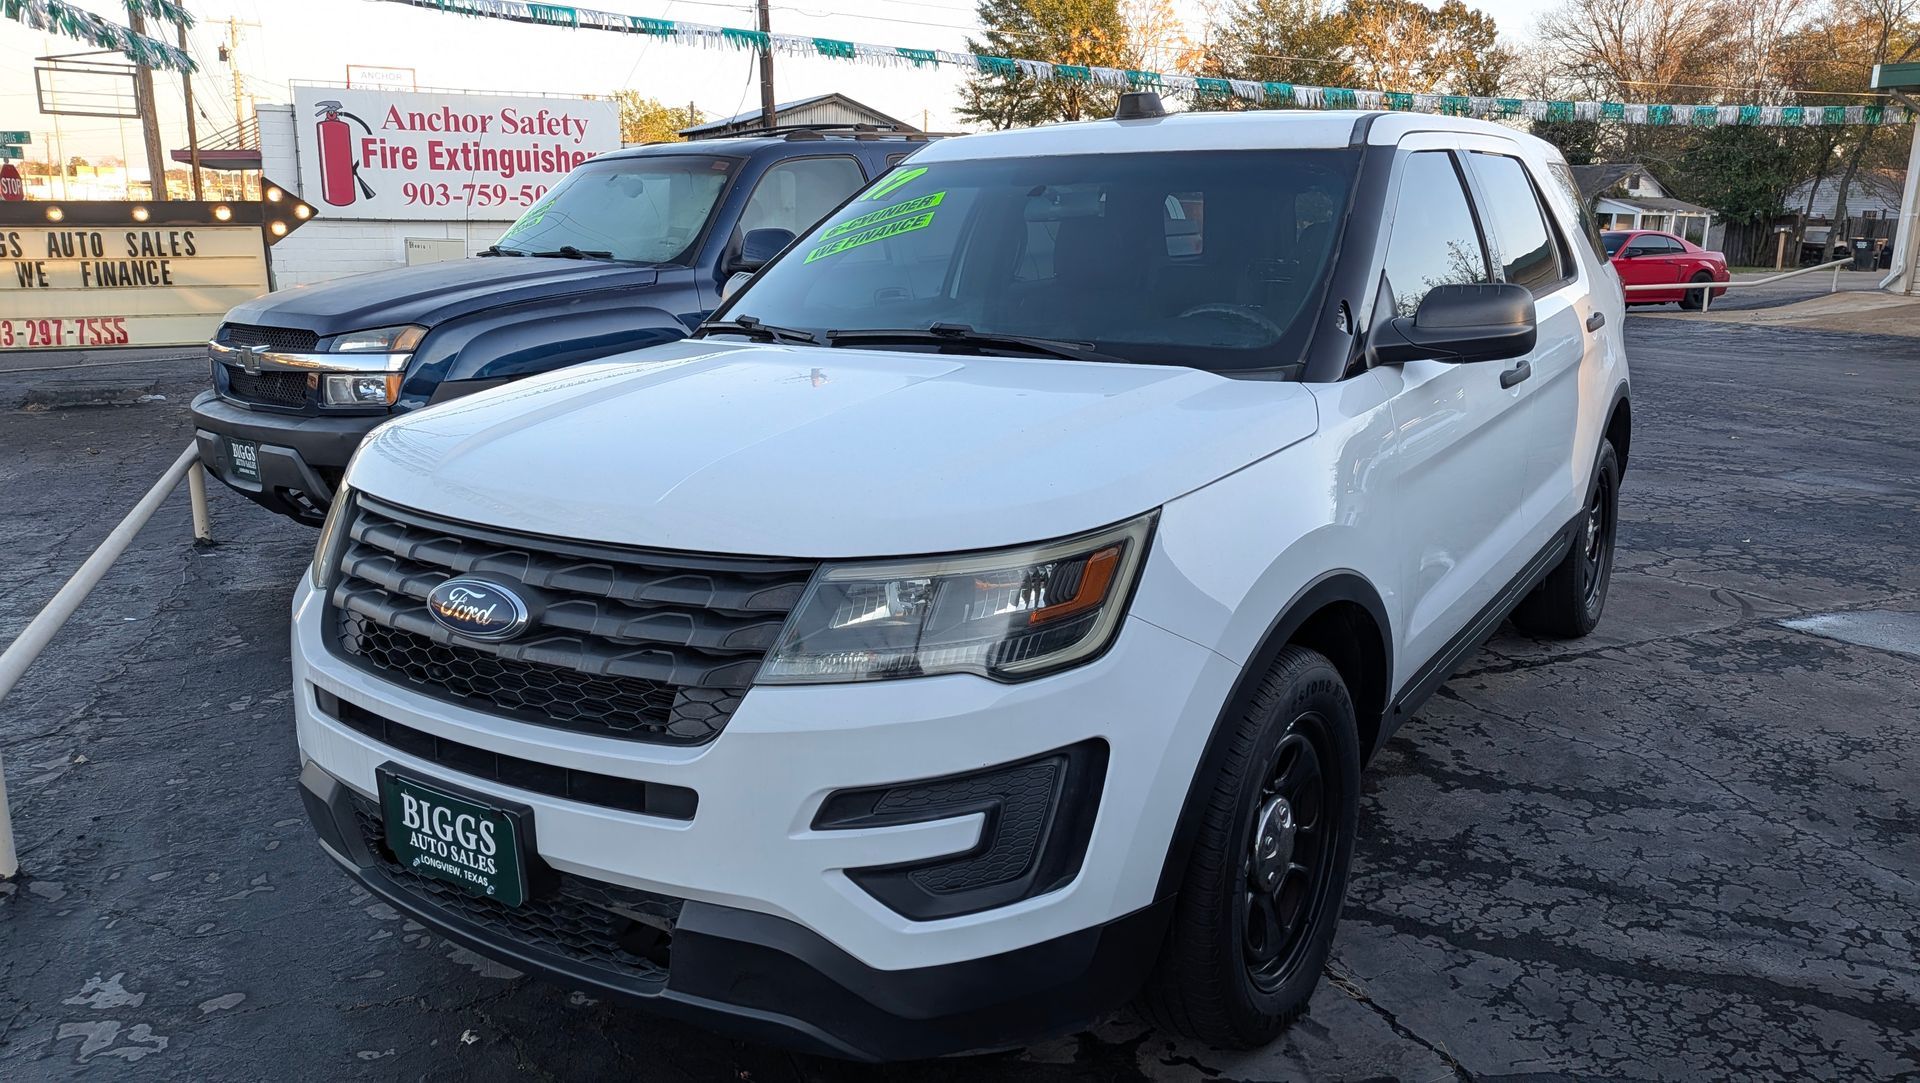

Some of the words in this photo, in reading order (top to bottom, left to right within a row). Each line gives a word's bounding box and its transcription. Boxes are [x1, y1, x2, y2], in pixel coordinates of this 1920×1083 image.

[381, 103, 493, 133] Anchor
[500, 107, 589, 144] Safety
[361, 137, 418, 169] Fire
[428, 140, 606, 178] Extinguishe
[1, 177, 21, 195] STOP
[47, 231, 104, 258] AUTO
[126, 231, 197, 257] SALES
[811, 241, 843, 260] WE
[841, 214, 928, 249] FINANCE
[14, 260, 49, 288] WE
[80, 259, 173, 288] FINANCE
[231, 443, 256, 461] BIGGS
[440, 587, 497, 626] Ford
[400, 792, 496, 856] BIGGS
[409, 831, 448, 858] AUTO
[450, 845, 496, 875] SALES
[420, 854, 463, 879] LONGVIEW,
[463, 871, 488, 887] TEXAS
